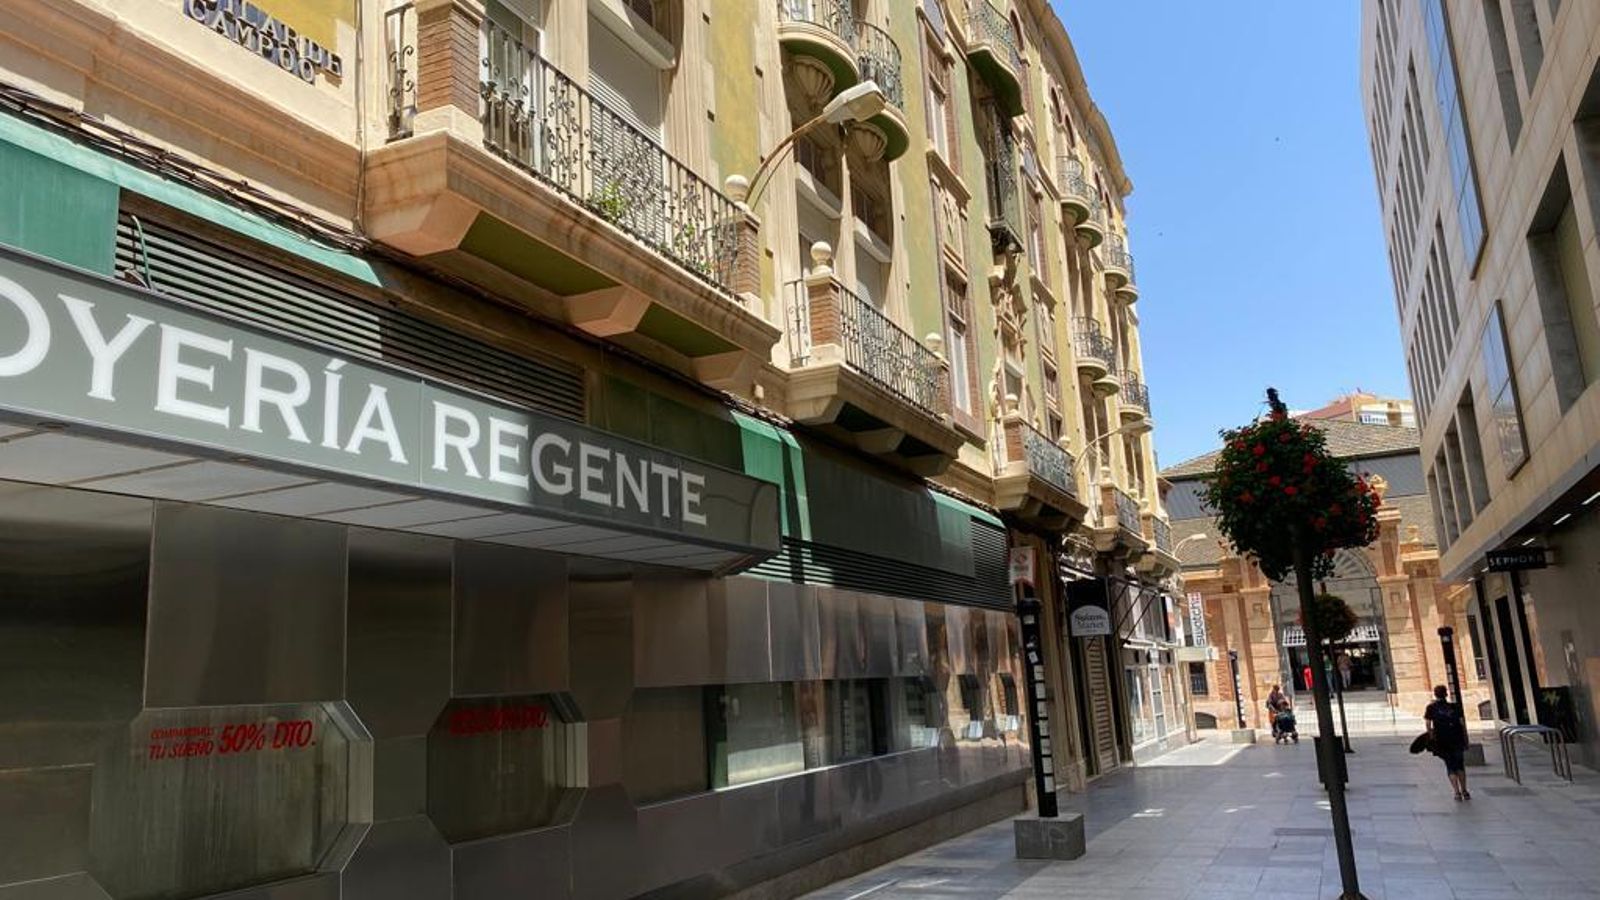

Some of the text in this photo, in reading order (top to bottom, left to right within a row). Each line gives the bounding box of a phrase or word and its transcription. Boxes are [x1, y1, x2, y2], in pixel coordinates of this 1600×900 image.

[188, 0, 316, 83] CAMPOO
[432, 400, 707, 526] REGENTE
[149, 744, 165, 760] TU
[218, 720, 316, 754] 50% DTO.
